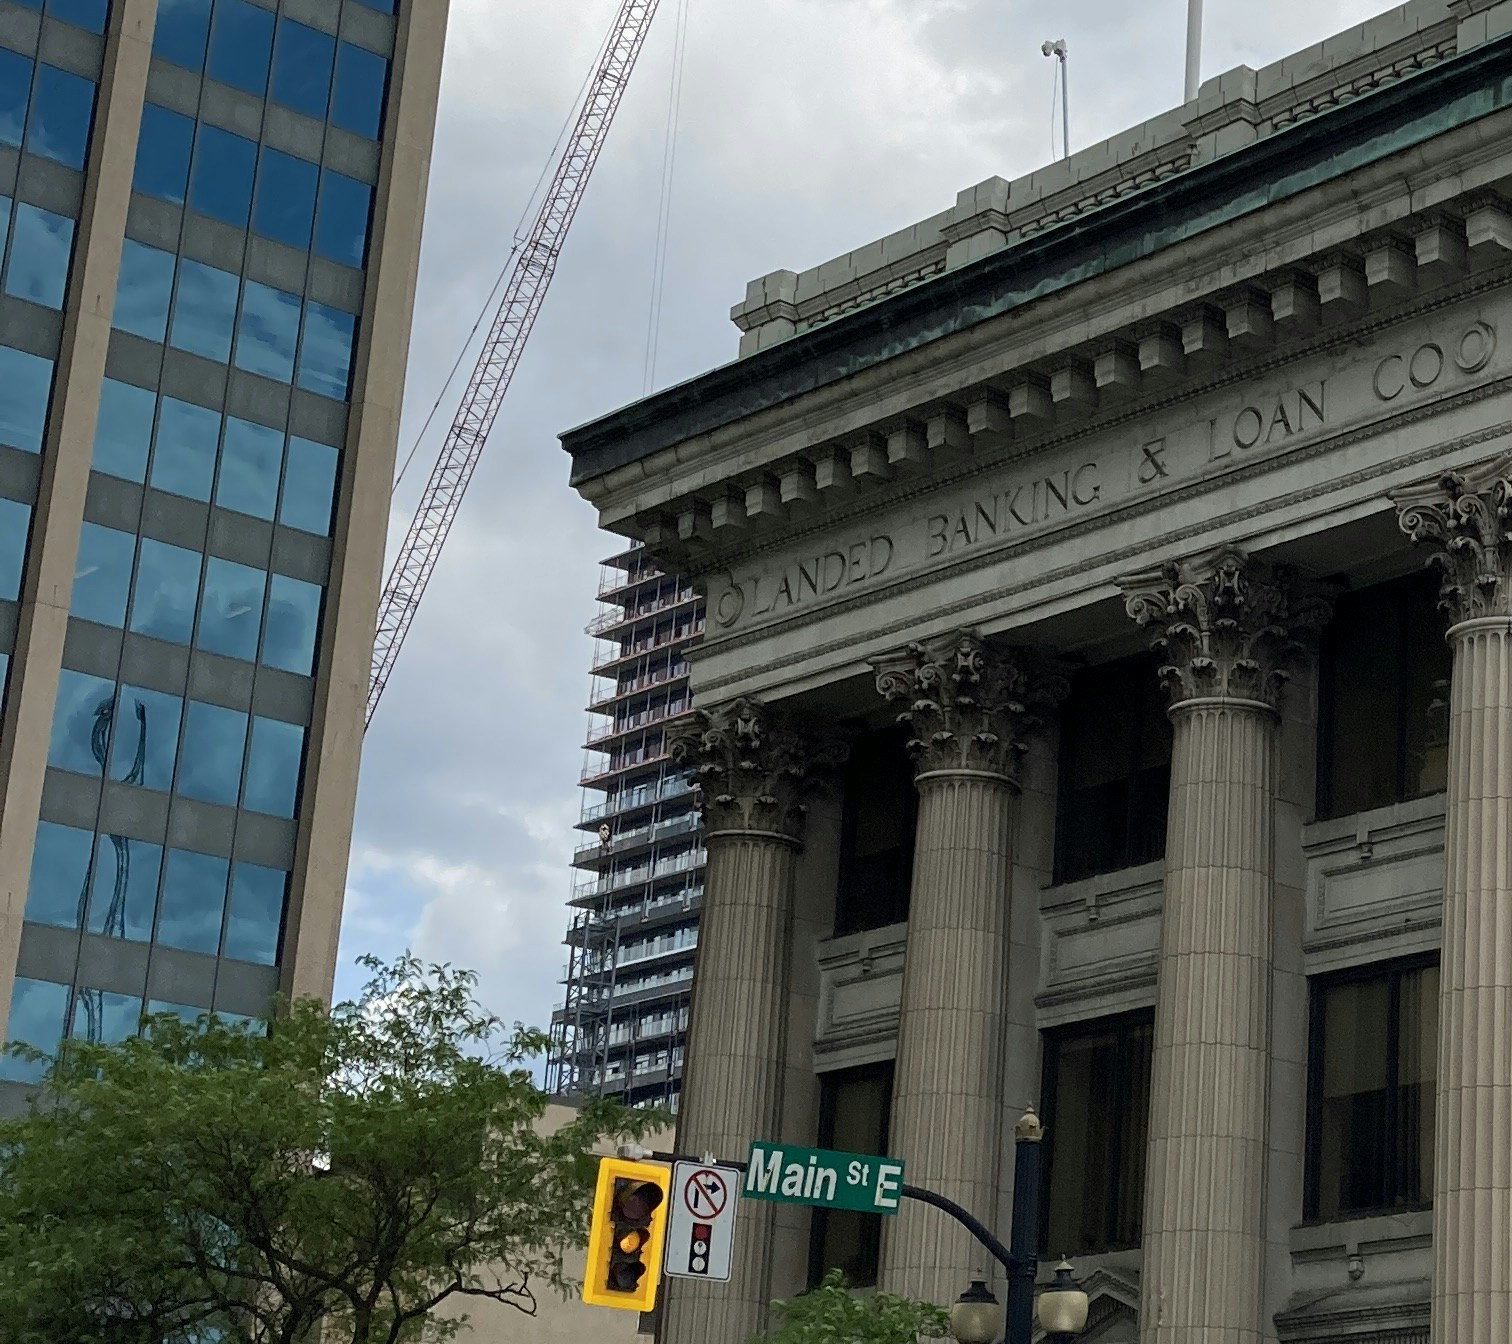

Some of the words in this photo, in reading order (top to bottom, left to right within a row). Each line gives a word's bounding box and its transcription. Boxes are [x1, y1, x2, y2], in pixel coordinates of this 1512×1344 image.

[751, 533, 895, 617] LANDED
[924, 462, 1103, 558] BANKING
[1137, 436, 1170, 484] &
[1208, 379, 1328, 460] LOAN
[747, 1148, 837, 1200] Main
[846, 1160, 870, 1187] St
[873, 1164, 902, 1208] E
